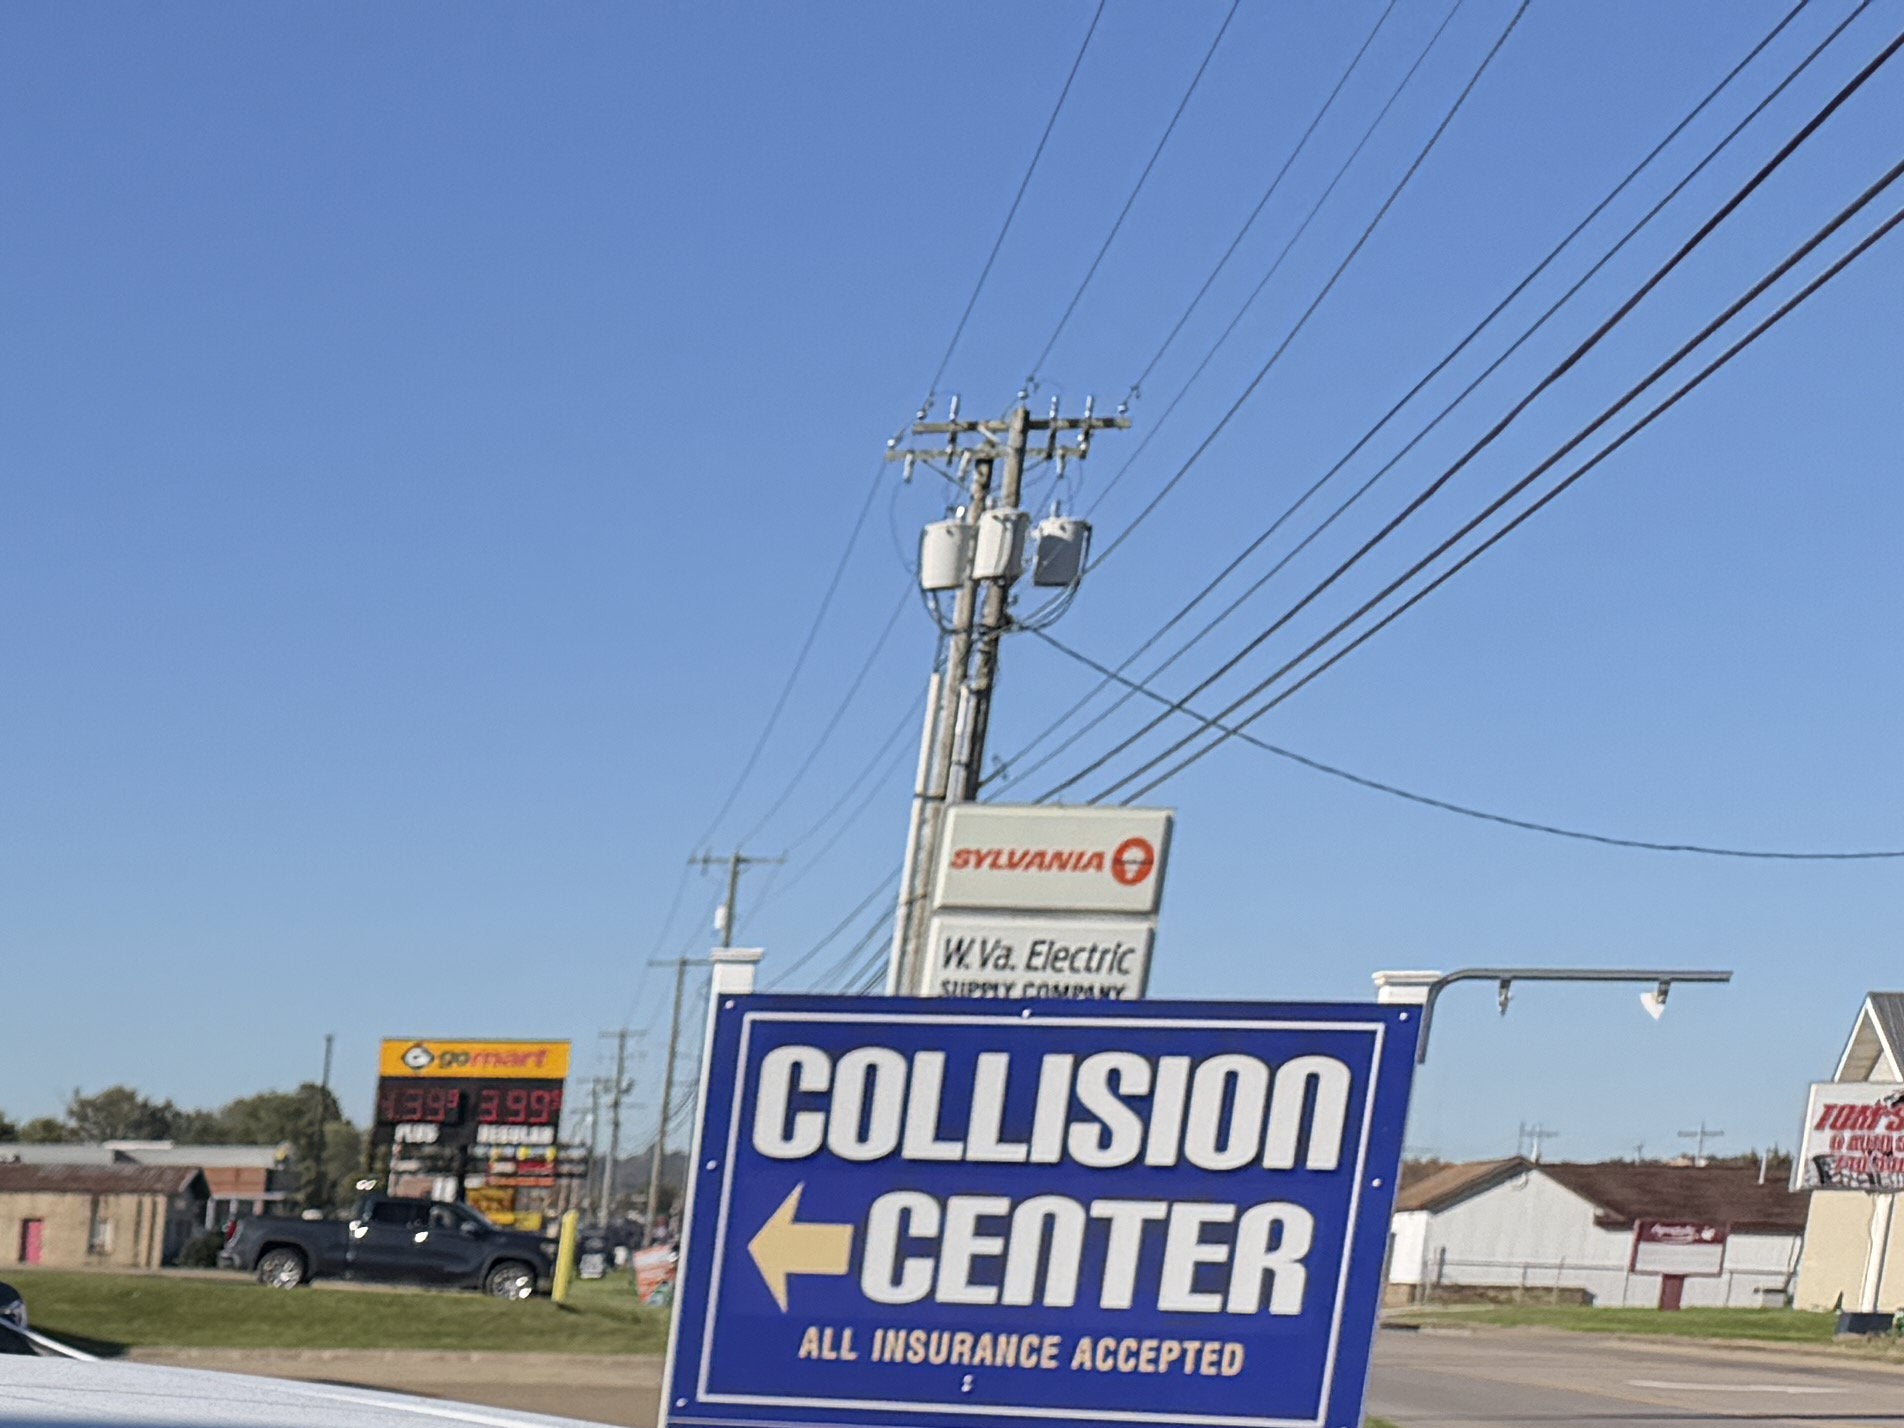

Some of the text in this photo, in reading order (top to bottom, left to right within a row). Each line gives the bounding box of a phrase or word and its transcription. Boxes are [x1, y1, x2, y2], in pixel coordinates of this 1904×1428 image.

[951, 847, 1106, 872] SYLVANIA
[1024, 939, 1136, 975] Electric
[941, 980, 1126, 999] SUPPLY COMPANY
[750, 1044, 1352, 1173] COLLISION
[859, 1191, 1315, 1317] CENTER
[799, 1326, 1247, 1377] ALL INSURANCE ACCEPTED
